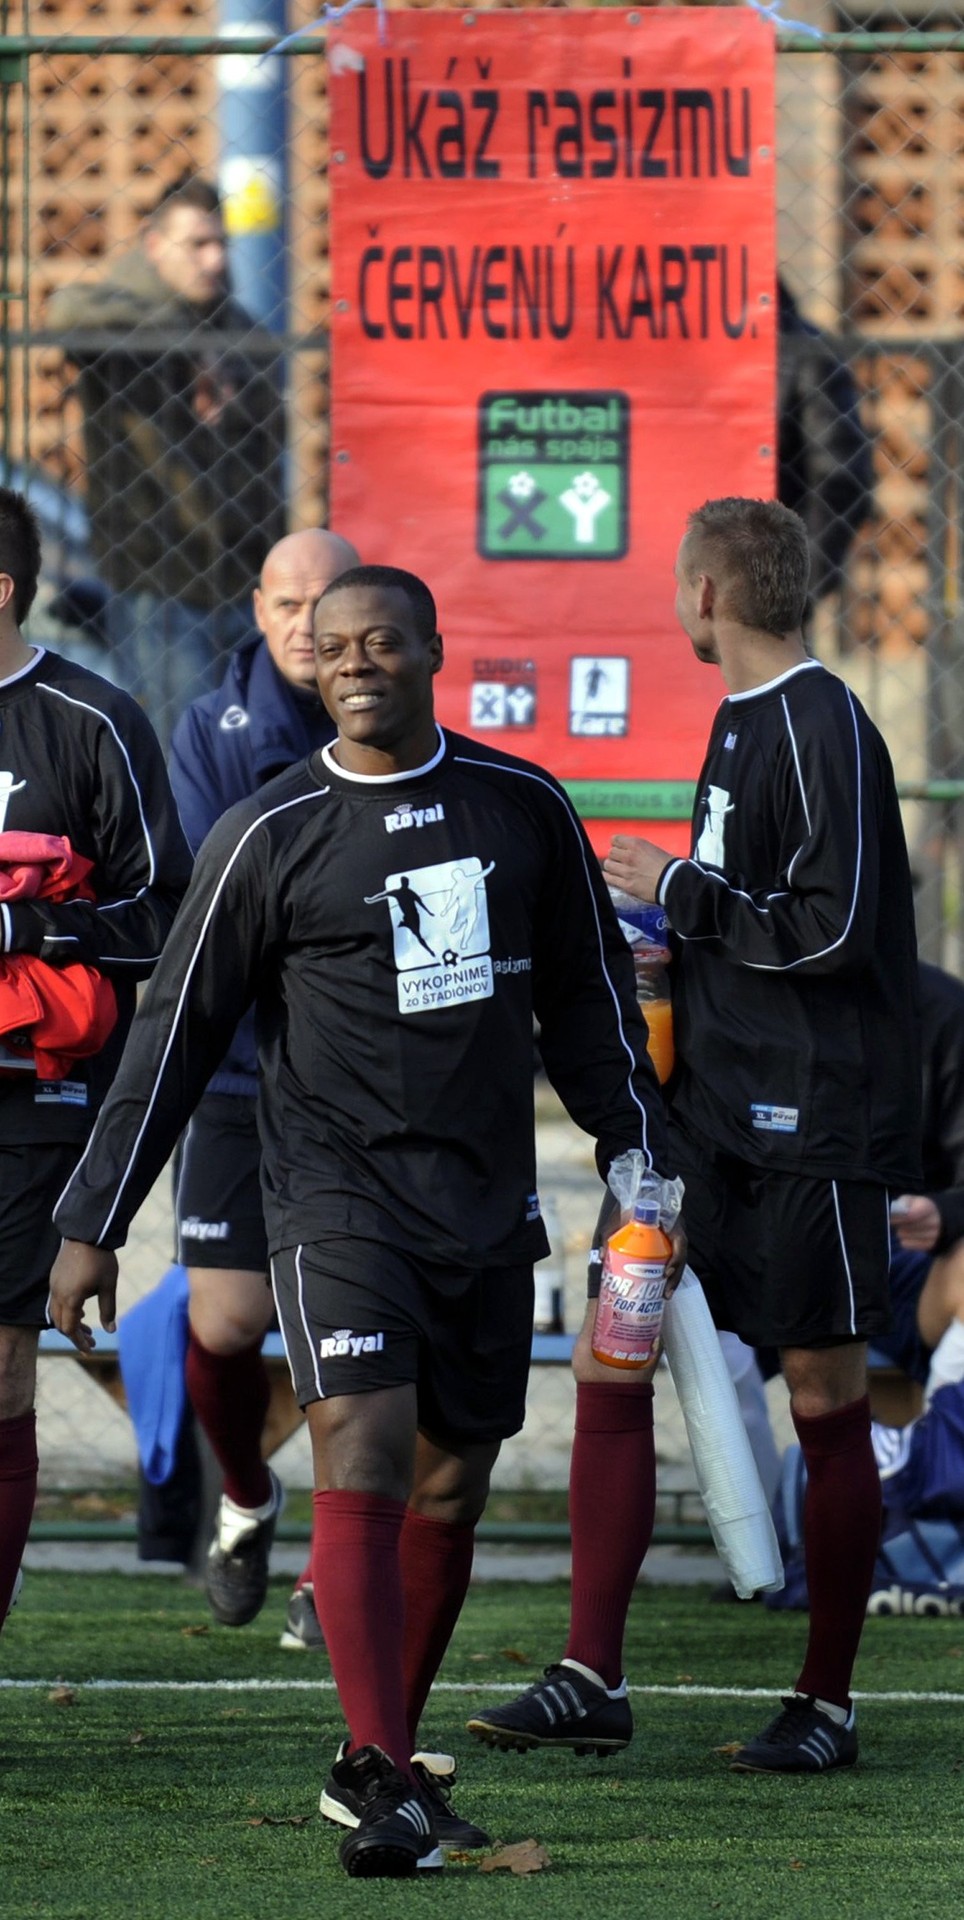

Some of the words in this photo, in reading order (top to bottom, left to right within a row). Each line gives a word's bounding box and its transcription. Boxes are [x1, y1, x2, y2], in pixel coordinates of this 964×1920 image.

[358, 57, 500, 179] Ukáž
[527, 57, 751, 178] rasizmu
[358, 223, 574, 340] ČERVENÚ
[597, 244, 757, 340] KARTU.
[489, 399, 619, 431] Futbal
[488, 435, 536, 457] nás
[545, 435, 618, 461] spája
[384, 804, 445, 833] Royal
[402, 965, 489, 993] VYKOPNIME
[422, 981, 488, 1005] ŠTADIÓNOV
[181, 1221, 229, 1240] Royal
[613, 1299, 636, 1312] FOR
[321, 1332, 384, 1358] Royal
